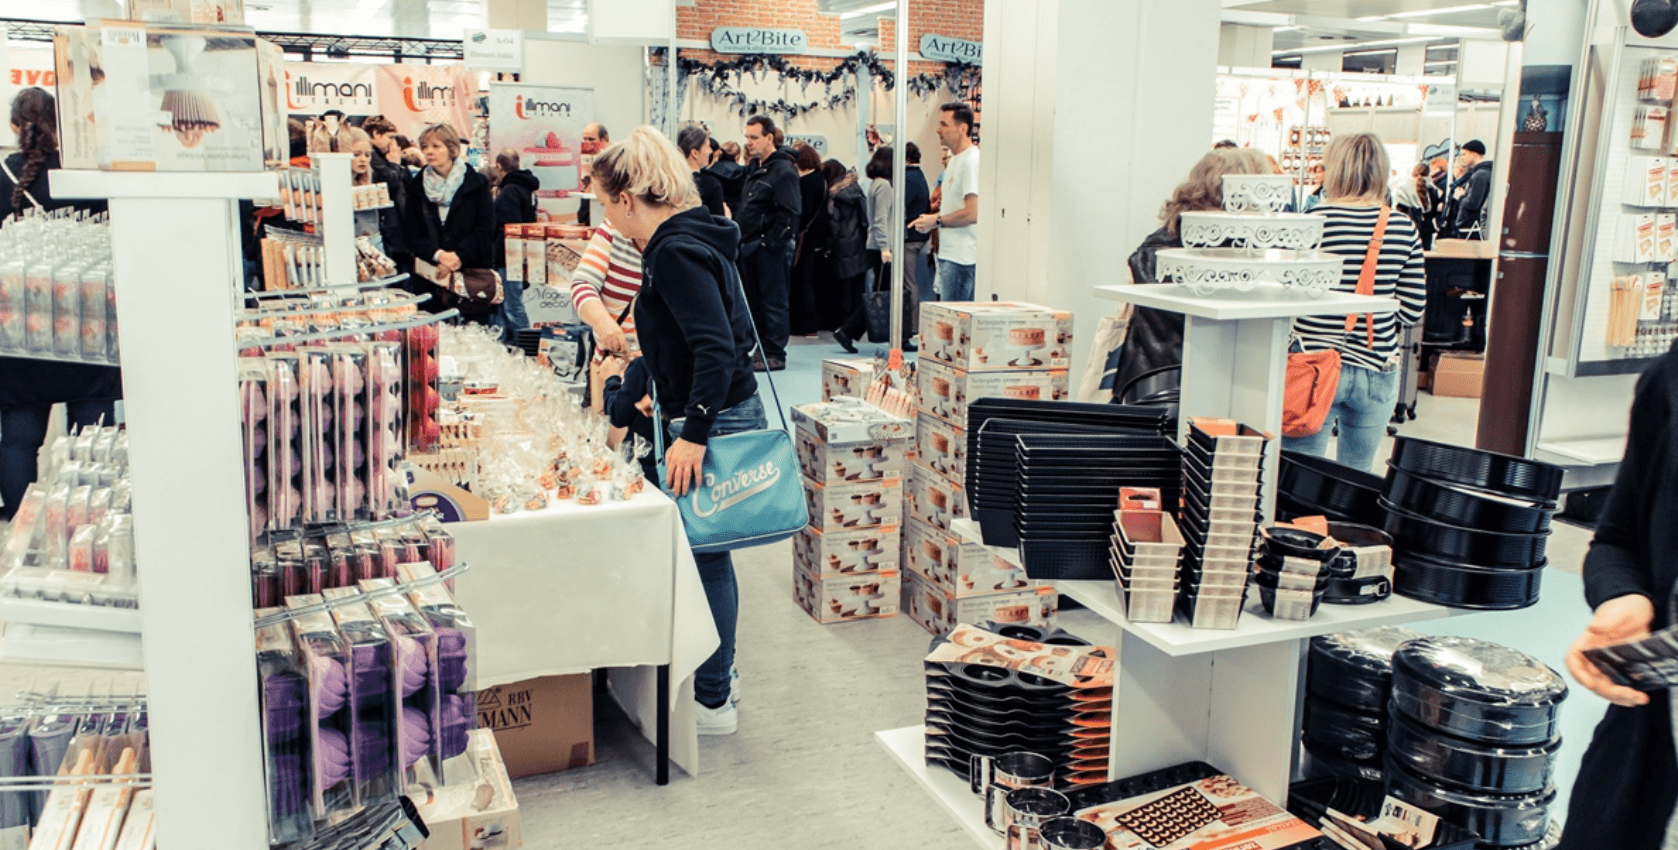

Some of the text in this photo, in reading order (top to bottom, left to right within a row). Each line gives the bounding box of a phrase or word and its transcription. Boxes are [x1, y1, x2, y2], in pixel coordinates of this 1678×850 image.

[718, 29, 801, 46] Art2Bite
[691, 461, 781, 518] Converse
[508, 688, 534, 706] RBV
